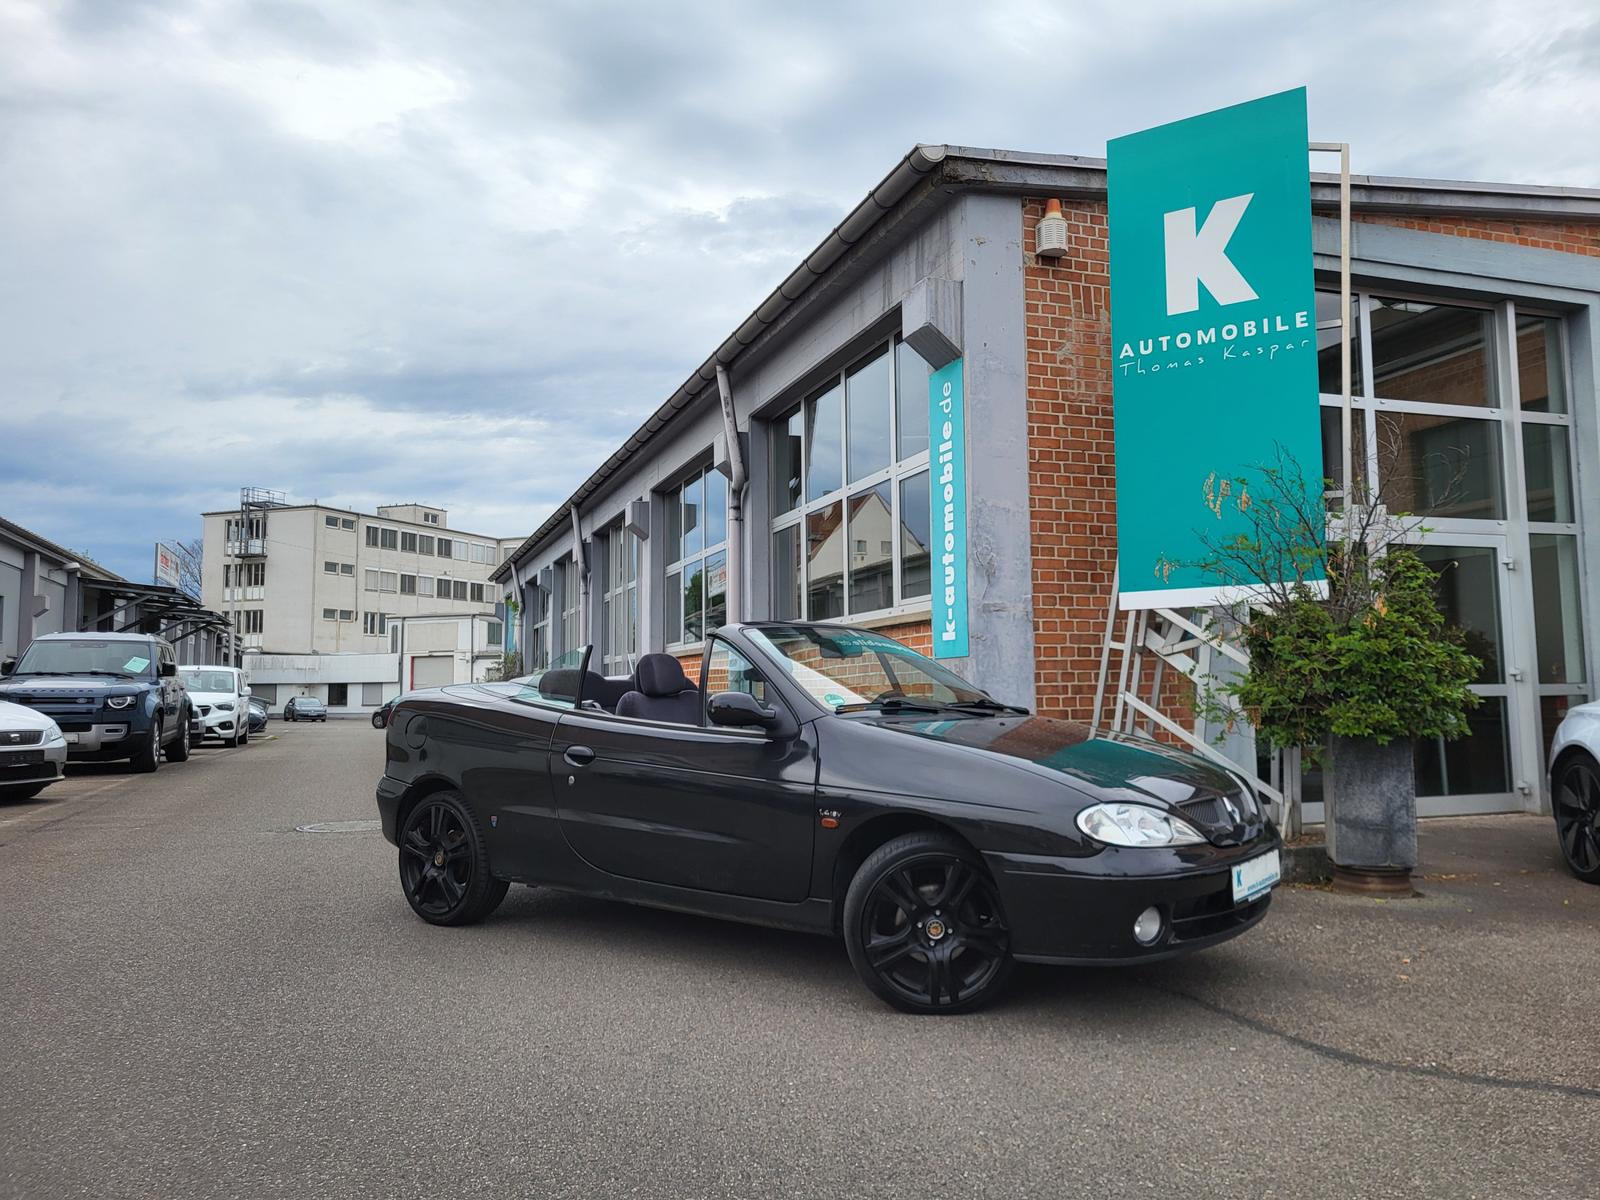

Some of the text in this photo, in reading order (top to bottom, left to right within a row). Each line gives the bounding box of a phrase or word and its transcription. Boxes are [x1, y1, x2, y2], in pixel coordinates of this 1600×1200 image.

[1163, 192, 1260, 316] K
[1119, 311, 1309, 359] AUTOMOBILE
[1119, 338, 1310, 376] Thomas Kaspar
[939, 381, 956, 641] k-automobile.de
